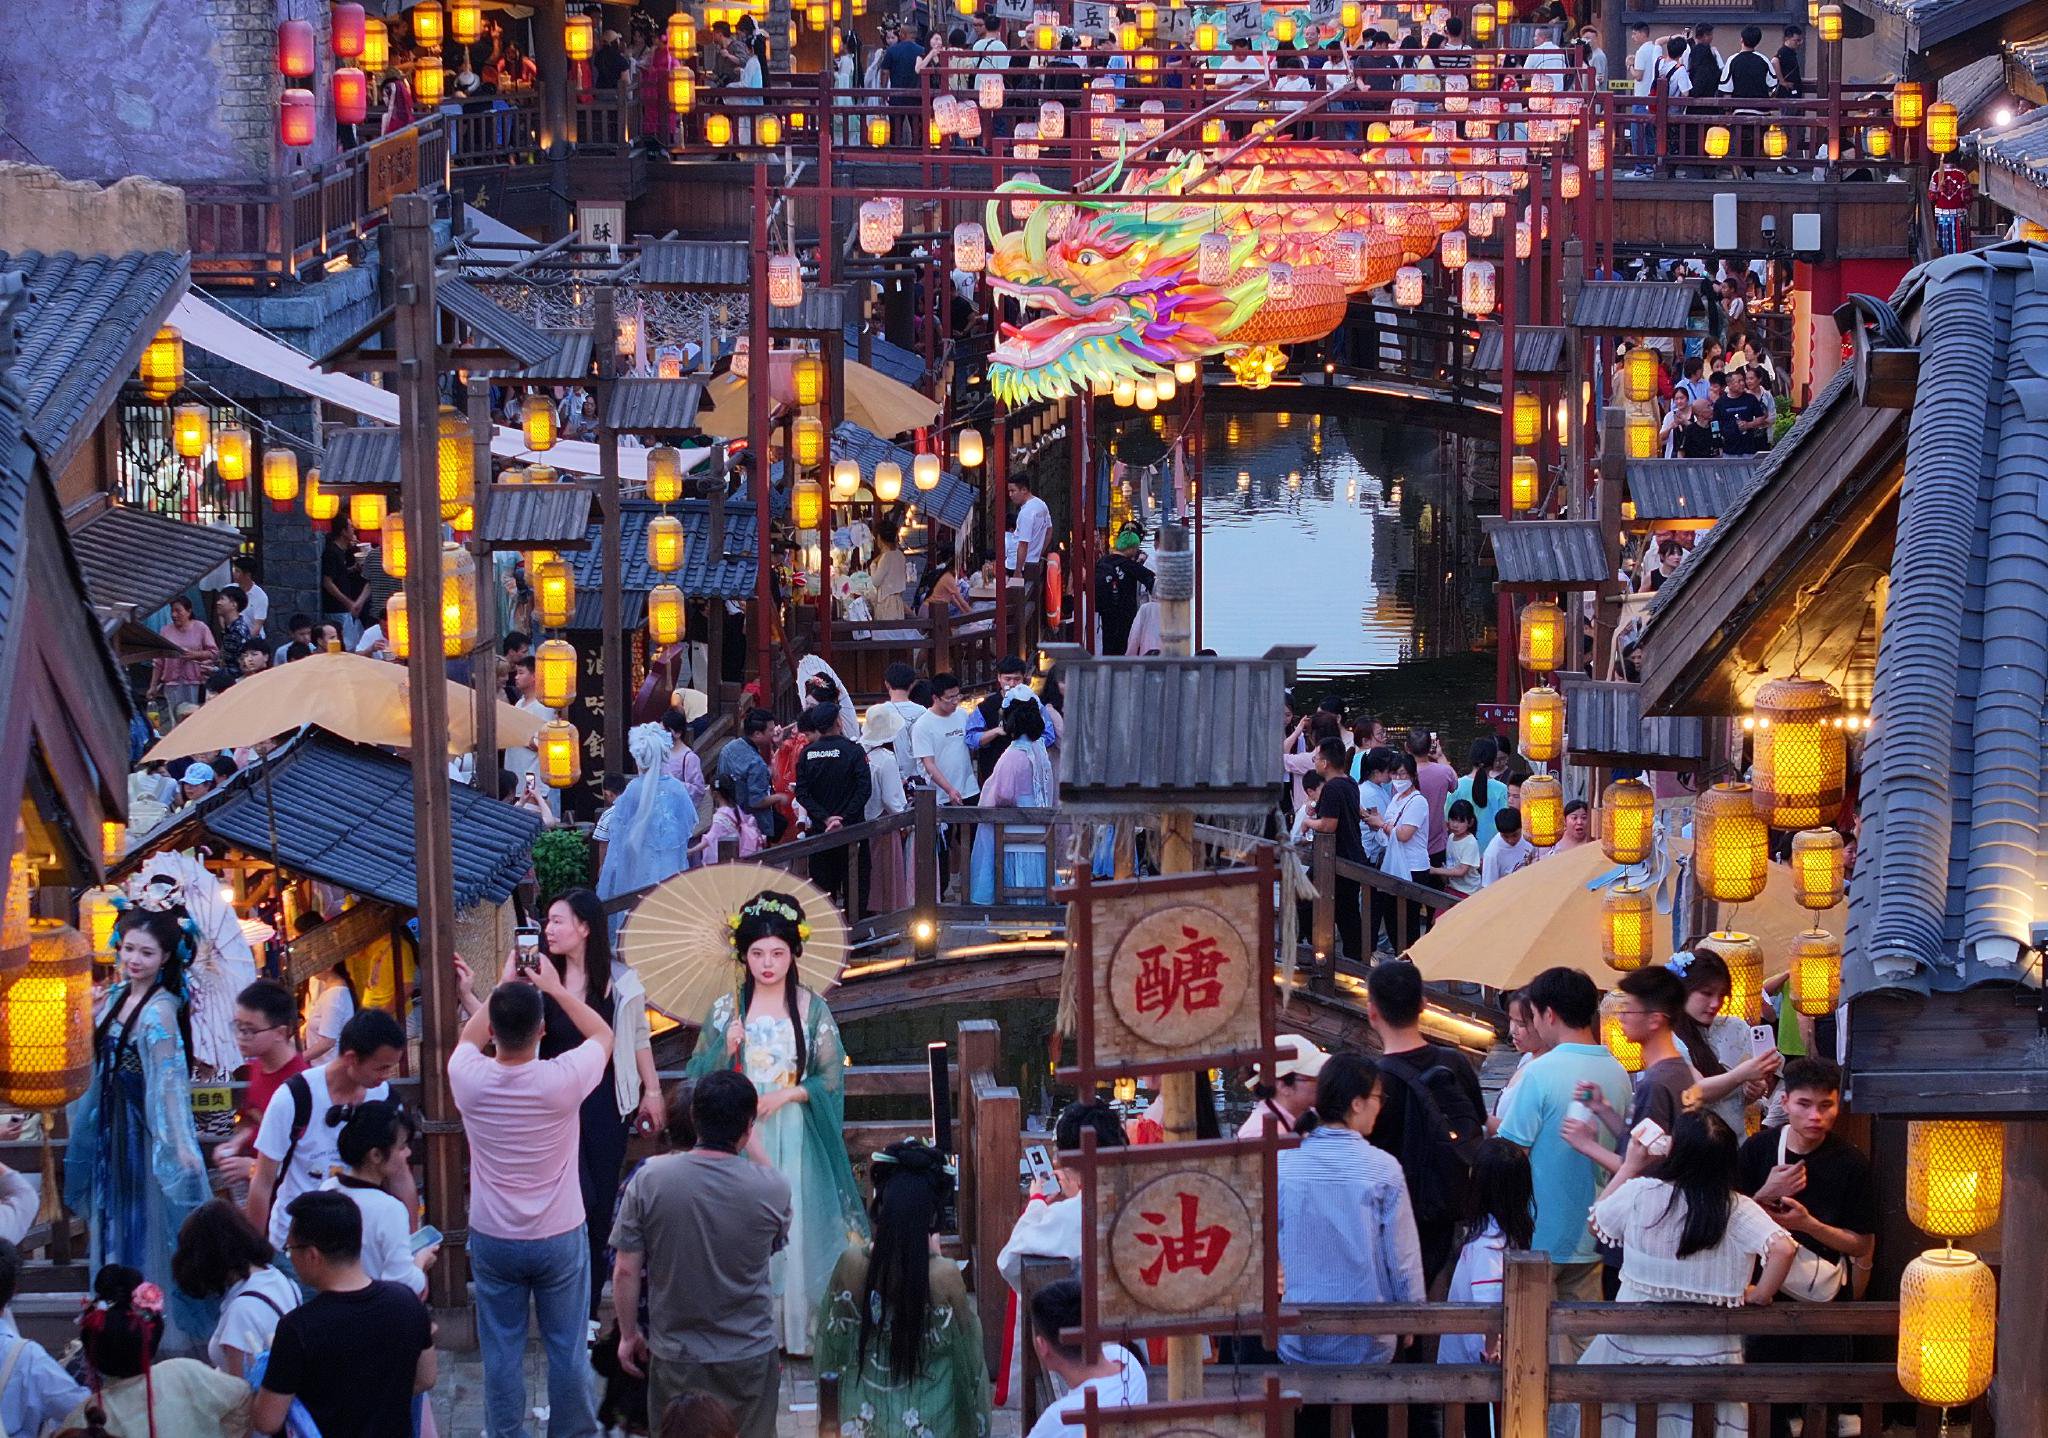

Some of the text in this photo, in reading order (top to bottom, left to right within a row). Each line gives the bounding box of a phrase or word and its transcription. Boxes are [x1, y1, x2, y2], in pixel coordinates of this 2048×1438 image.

[1079, 6, 1104, 29] 岳
[1162, 9, 1184, 33] 小
[1232, 6, 1257, 30] 吃
[1132, 1191, 1232, 1288] 油
